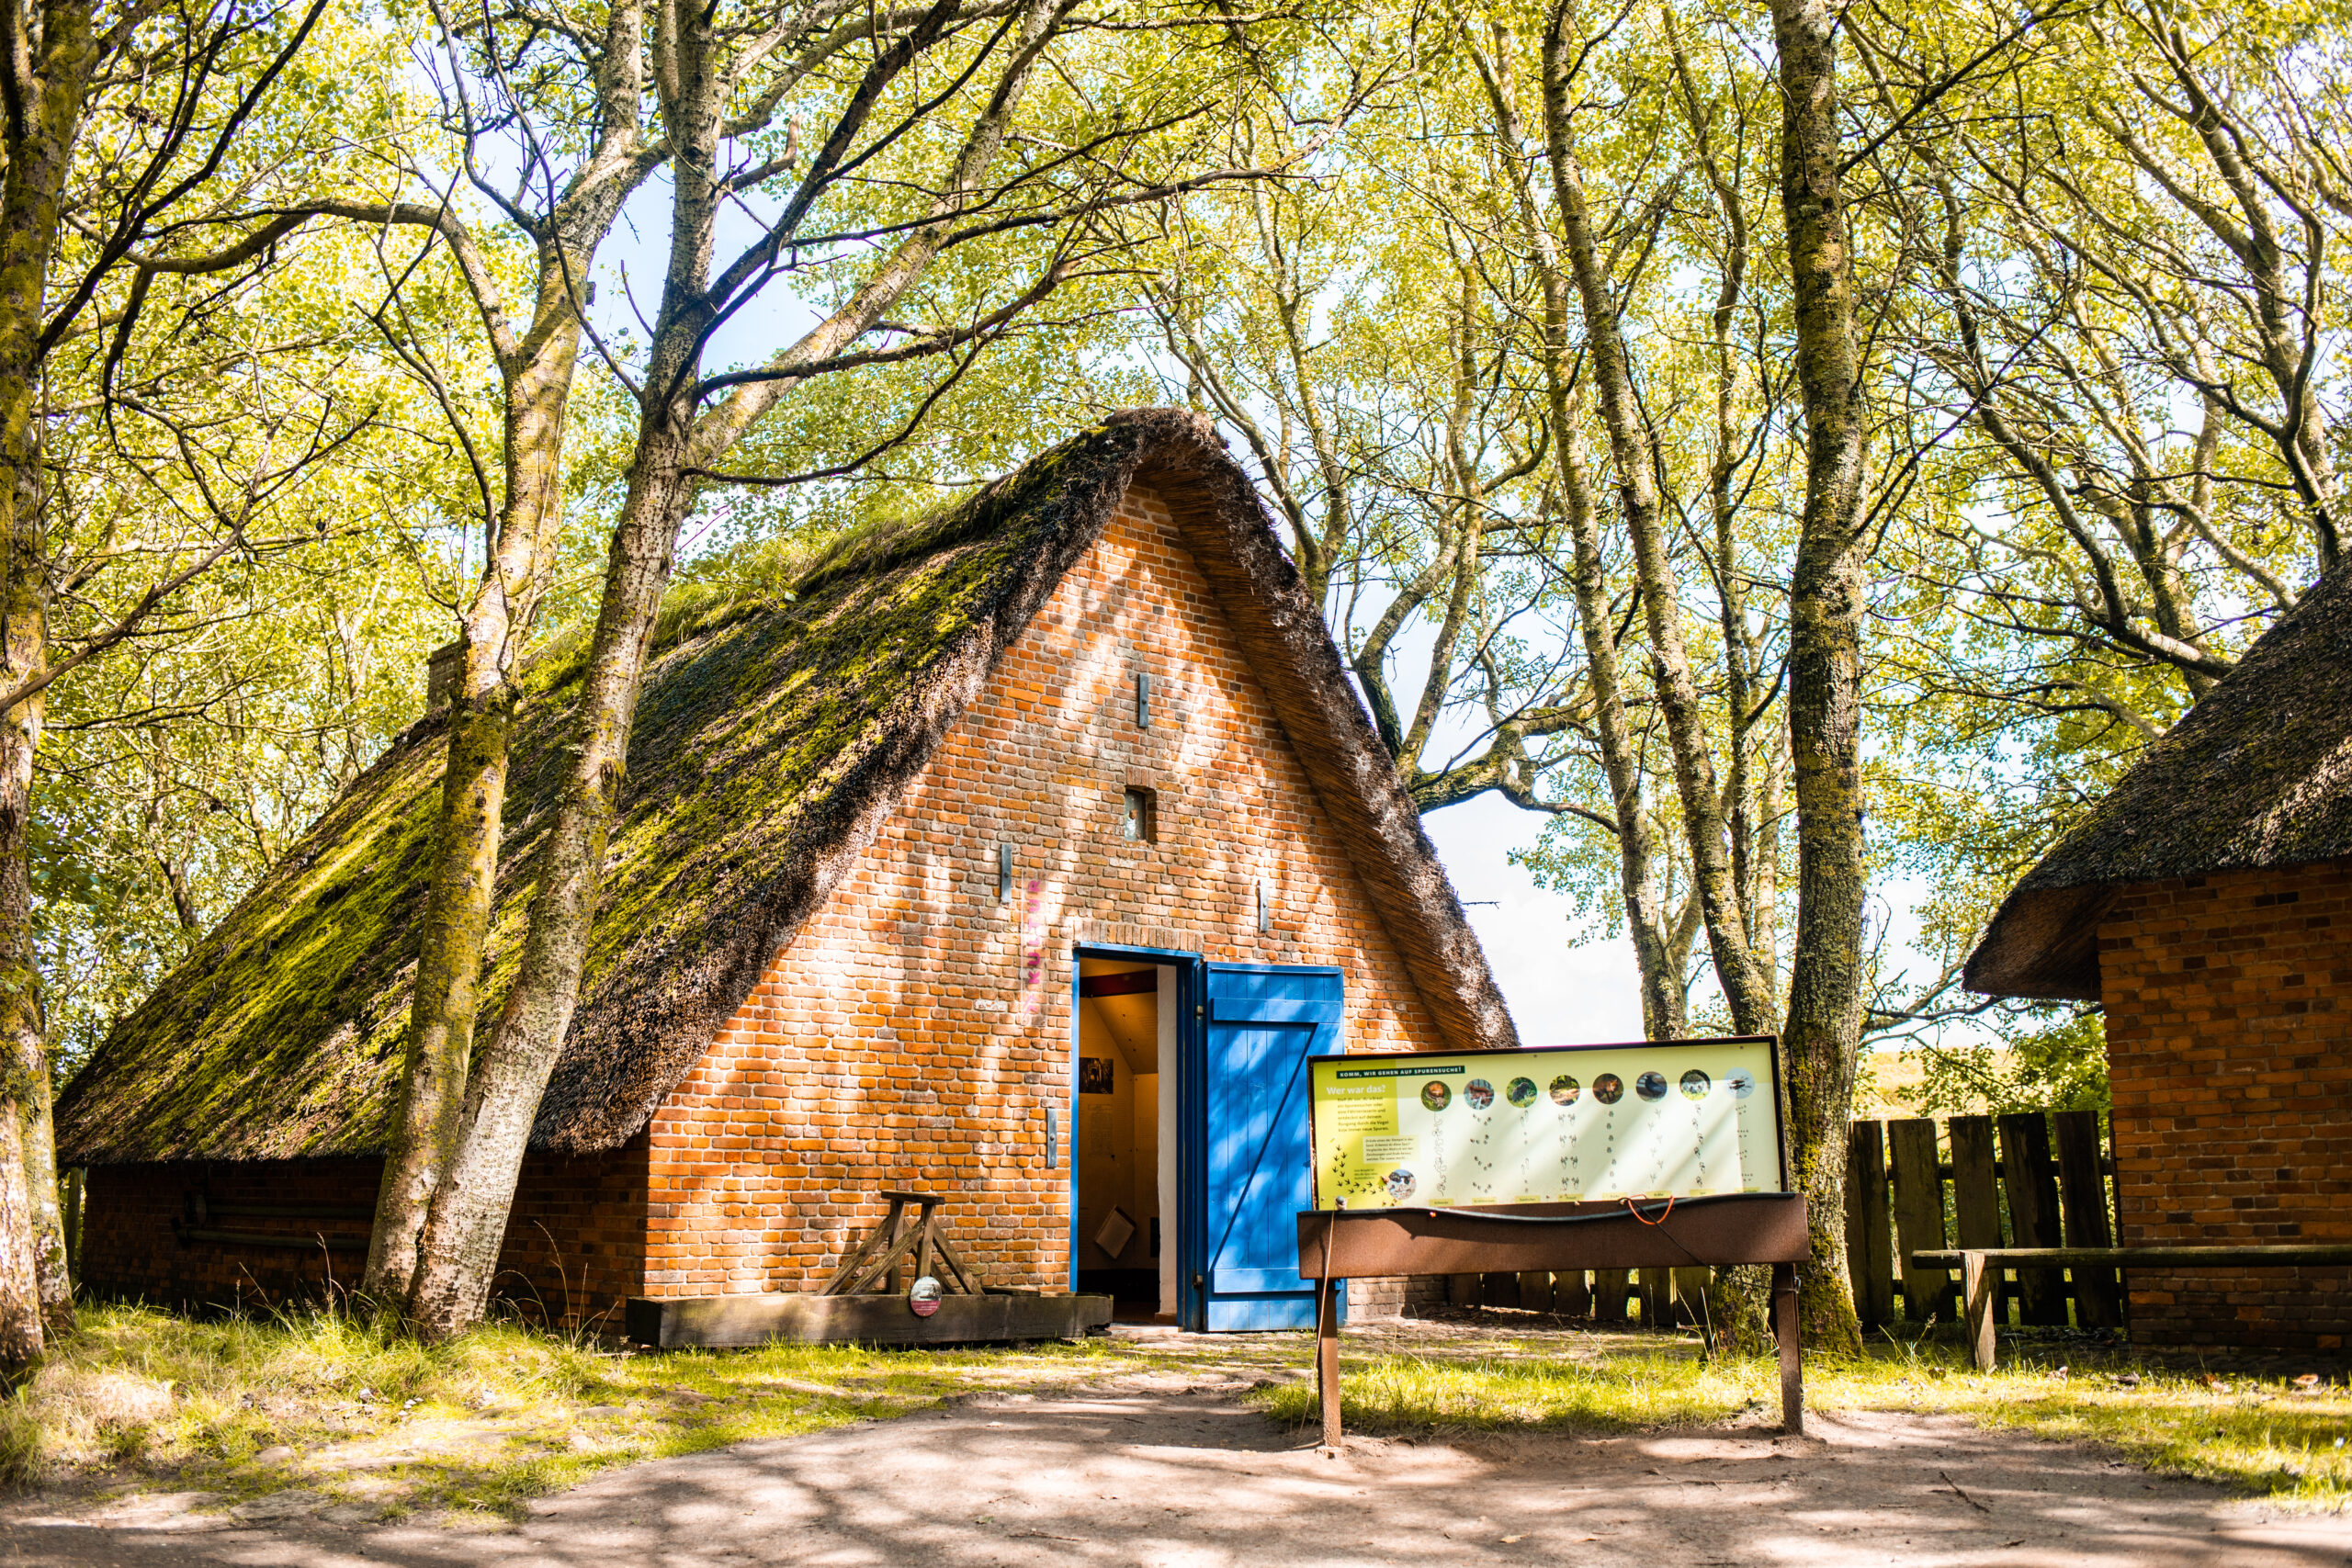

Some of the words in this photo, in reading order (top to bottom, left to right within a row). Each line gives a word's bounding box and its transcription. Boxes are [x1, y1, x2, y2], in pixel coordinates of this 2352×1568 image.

[1028, 879, 1041, 985] KULTUR
[1326, 1087, 1346, 1095] Wer
[1367, 1085, 1386, 1093] das?
